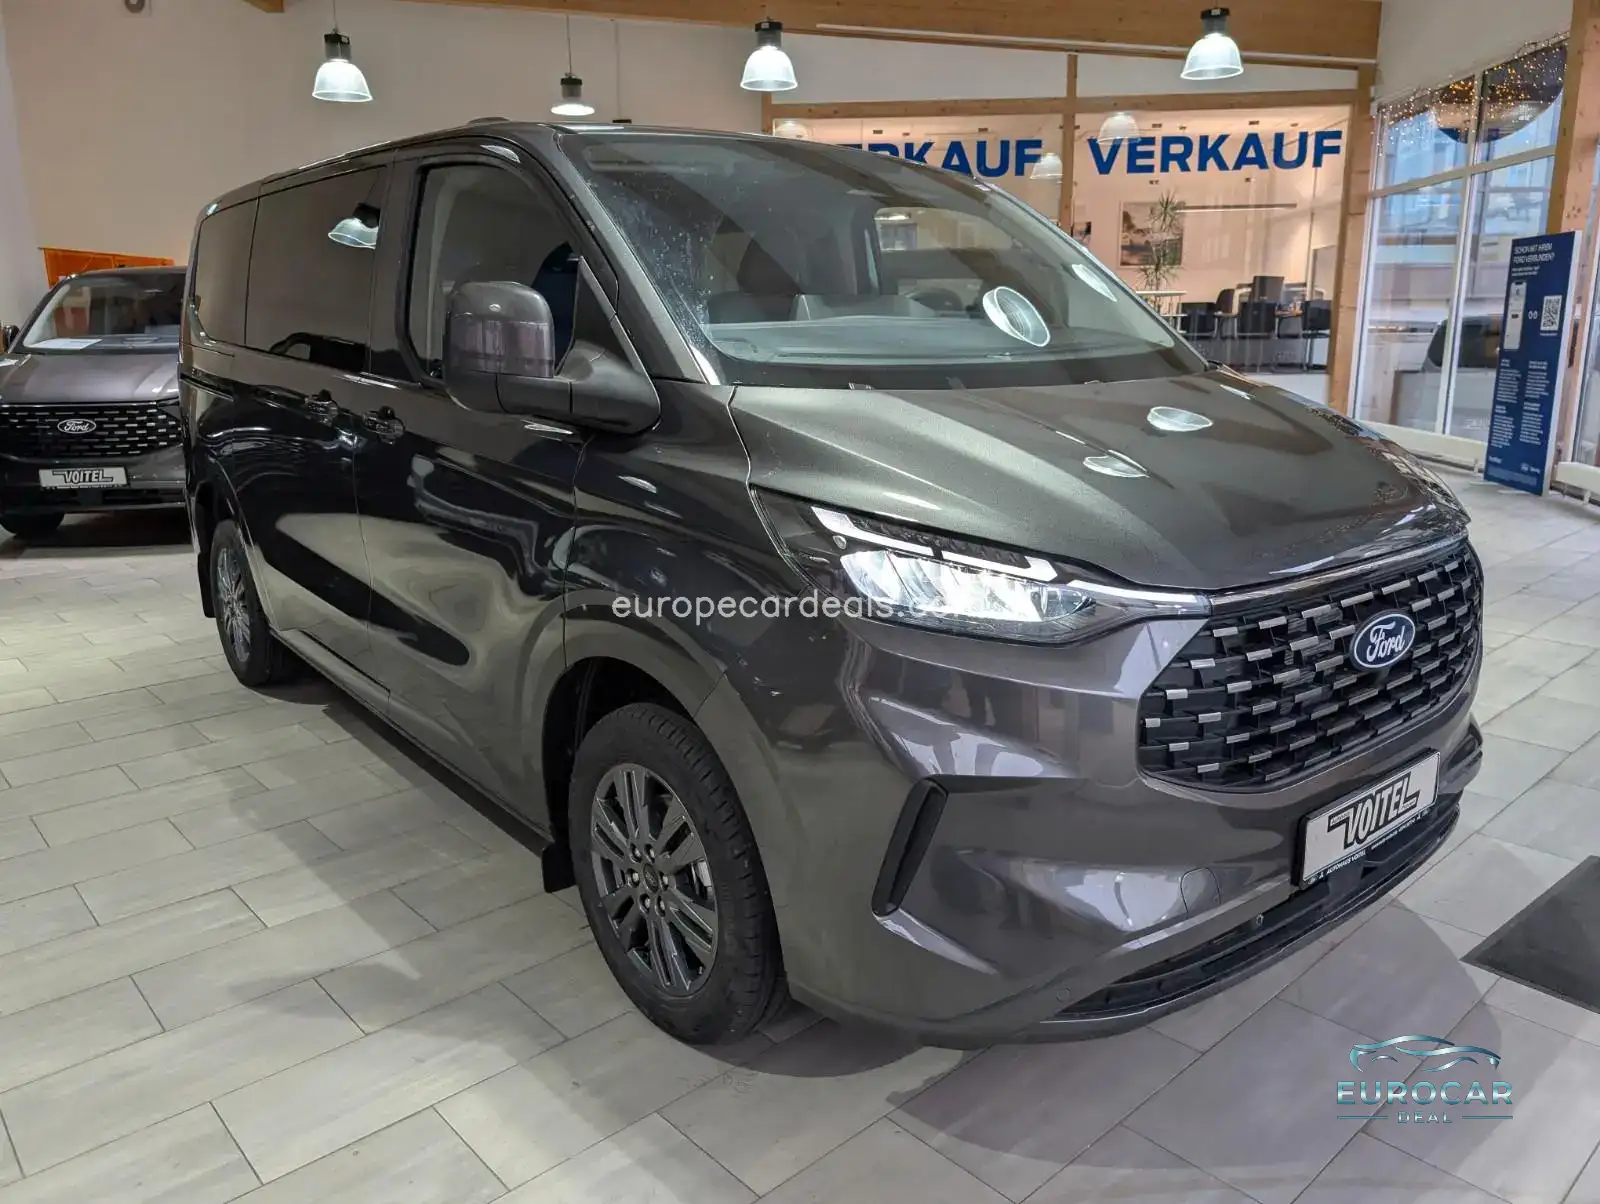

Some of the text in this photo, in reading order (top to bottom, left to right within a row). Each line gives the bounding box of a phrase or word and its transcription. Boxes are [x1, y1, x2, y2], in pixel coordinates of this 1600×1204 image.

[1088, 130, 1342, 175] VERKAUF
[63, 420, 90, 432] Ford
[64, 469, 104, 484] VOITEL
[1365, 620, 1406, 663] Ford
[1346, 777, 1410, 844] VOITEL
